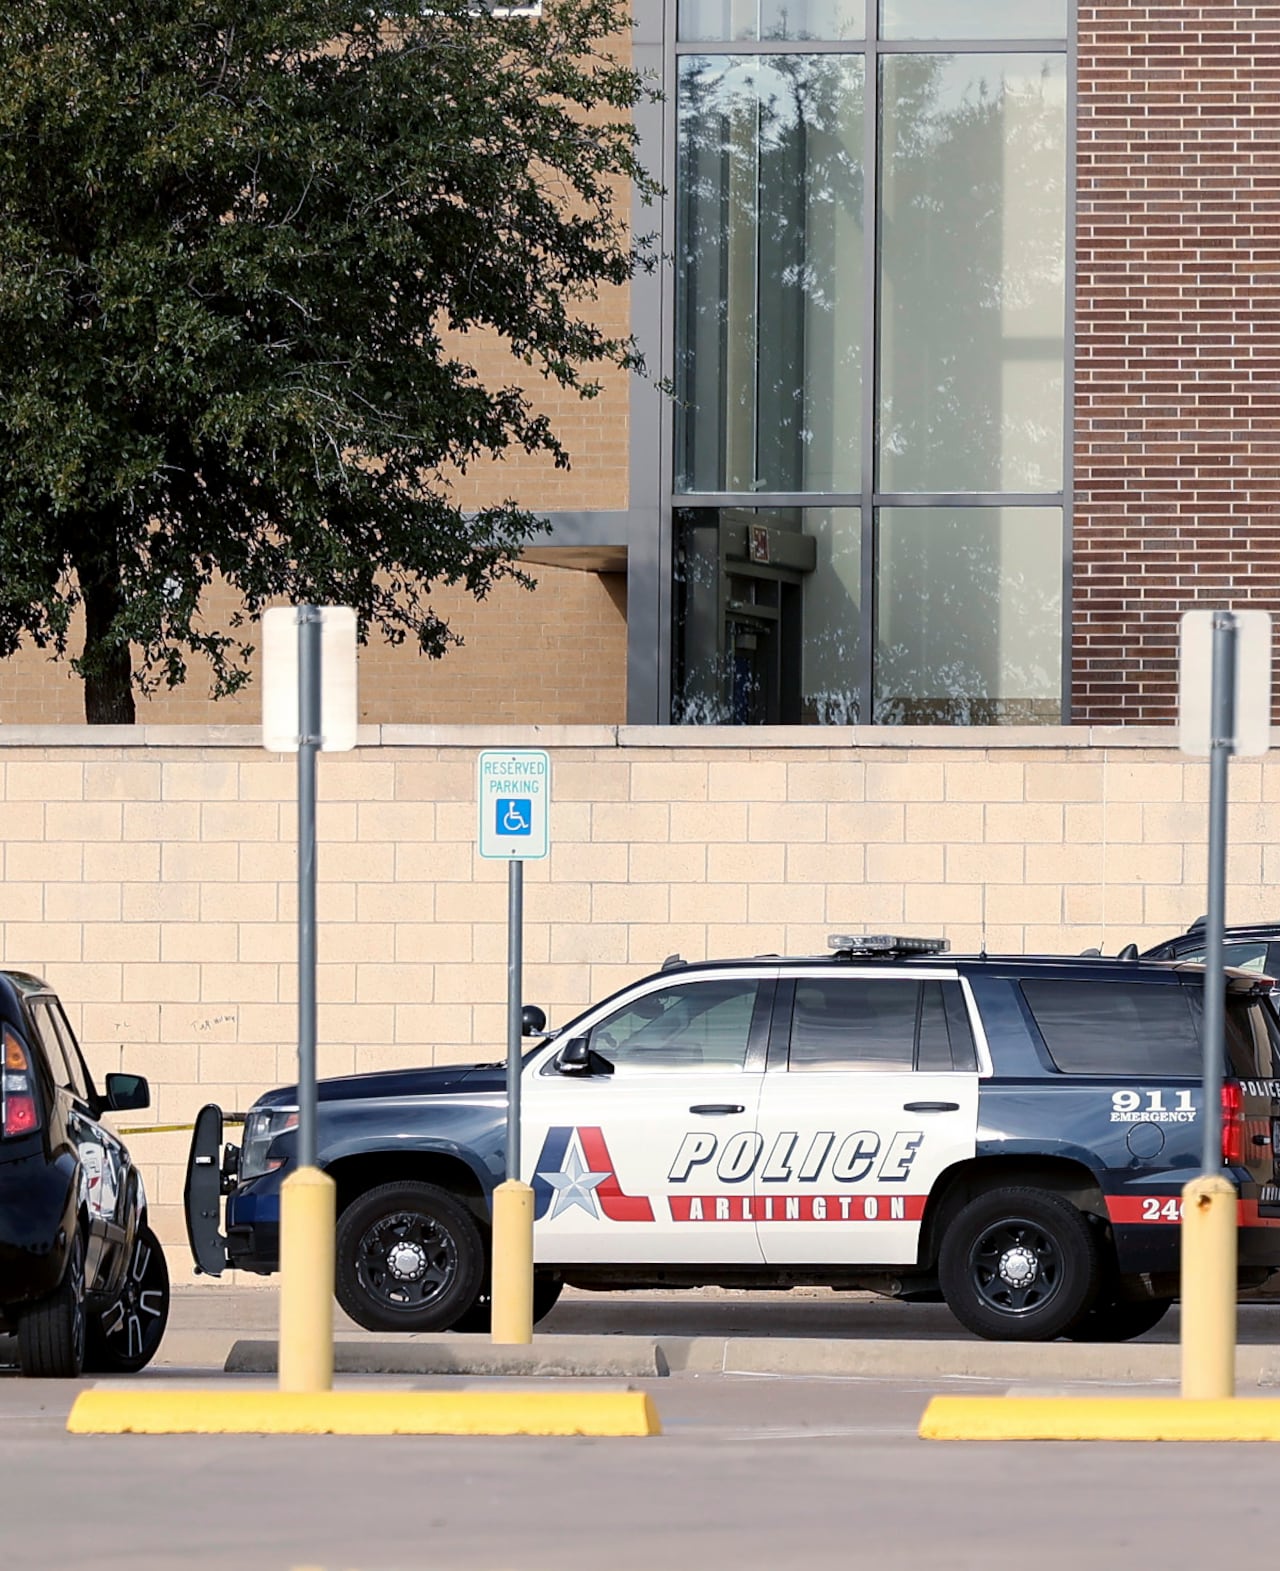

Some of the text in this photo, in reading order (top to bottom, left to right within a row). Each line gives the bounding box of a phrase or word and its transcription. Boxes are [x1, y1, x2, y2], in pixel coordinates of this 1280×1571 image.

[484, 761, 545, 775] RESERVED
[489, 780, 540, 793] PARKING
[1111, 1090, 1197, 1112] 911
[1110, 1112, 1197, 1122] EMERGENCY
[667, 1130, 925, 1184] POLICE
[689, 1196, 906, 1220] ARLINGTON
[1142, 1198, 1184, 1220] 24
